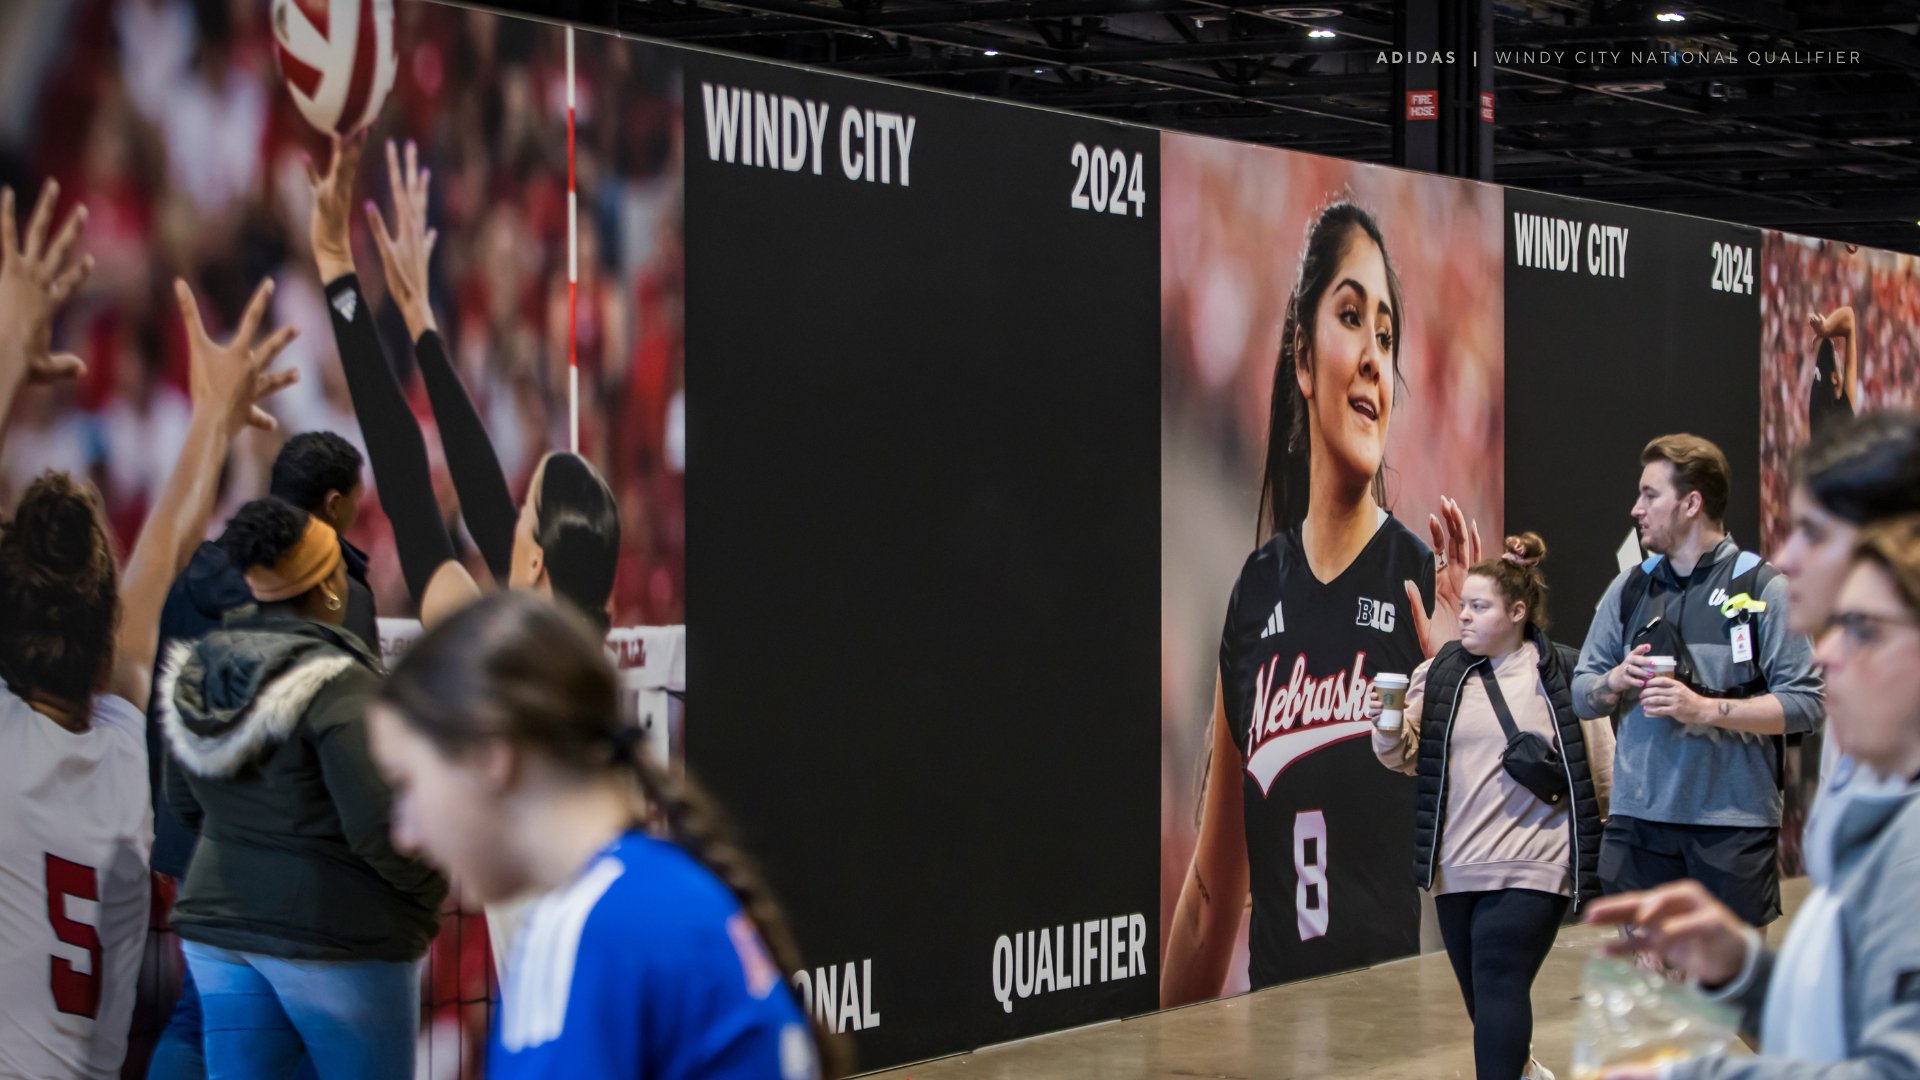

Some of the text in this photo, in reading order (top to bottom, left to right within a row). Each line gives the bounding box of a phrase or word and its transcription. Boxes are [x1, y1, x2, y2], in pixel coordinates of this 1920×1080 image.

[702, 83, 917, 187] WINDY CITY
[1410, 106, 1435, 116] HOSE
[1412, 95, 1433, 105] FIRE
[1070, 142, 1146, 218] 2024
[1514, 211, 1629, 279] WINDY CITY
[1710, 242, 1754, 295] 2024
[1292, 810, 1330, 942] 8
[45, 851, 104, 1021] 5
[992, 912, 1147, 1014] QUALIFIER
